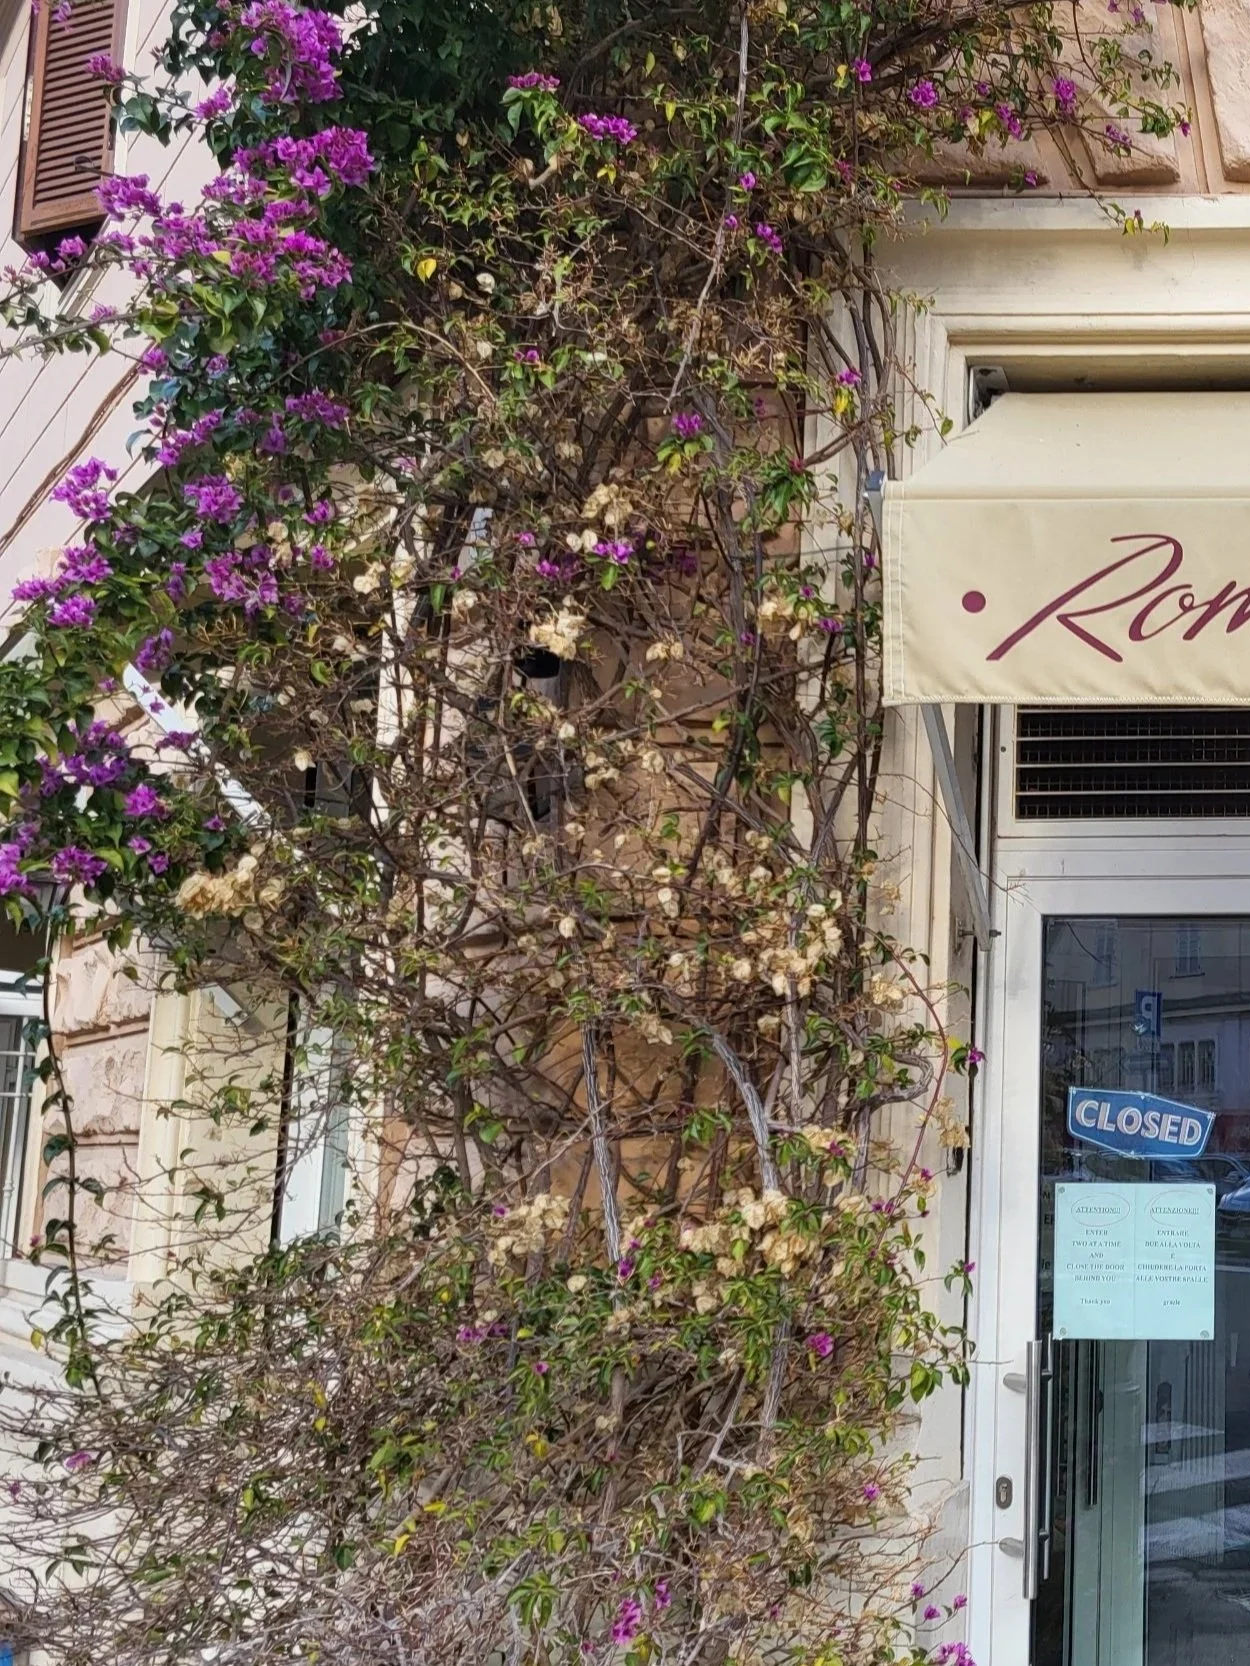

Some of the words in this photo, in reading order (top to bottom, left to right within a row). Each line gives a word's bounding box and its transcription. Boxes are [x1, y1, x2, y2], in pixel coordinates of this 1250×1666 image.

[1075, 1099, 1202, 1147] CLOSED
[1179, 1241, 1201, 1249] VOLTA
[1105, 1263, 1125, 1271] DOOR
